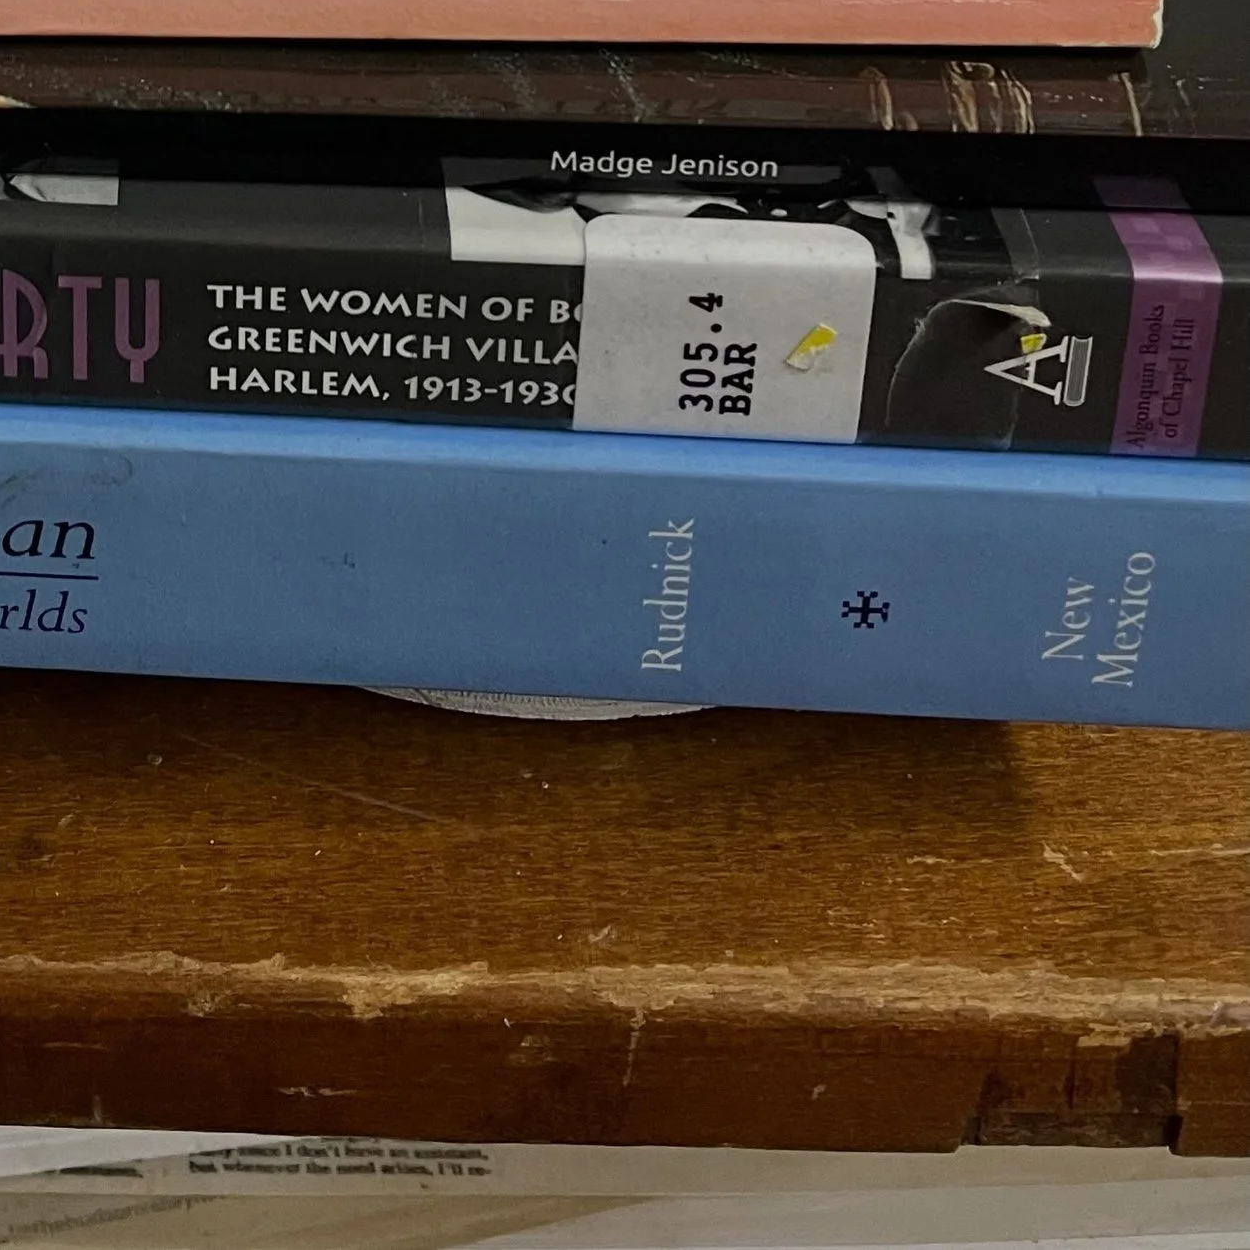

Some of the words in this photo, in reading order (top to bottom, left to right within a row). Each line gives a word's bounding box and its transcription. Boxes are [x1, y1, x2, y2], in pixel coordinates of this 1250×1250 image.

[550, 150, 653, 178] Madge
[662, 153, 779, 178] Jenison
[207, 284, 287, 312] THE
[300, 287, 468, 320] WOMEN
[481, 296, 535, 323] OF
[1139, 304, 1166, 356] Books
[208, 325, 450, 360] GREENWICH
[678, 292, 723, 412] 305.4
[1171, 318, 1196, 351] Hill
[209, 366, 390, 401] HARLEM,
[719, 342, 758, 416] BAR
[1126, 362, 1160, 448] Algonquin
[1162, 356, 1193, 417] Chapel
[1159, 416, 1178, 439] of
[641, 517, 696, 672] Rudnick
[1041, 576, 1096, 660] New
[1091, 551, 1157, 688] Mexico
